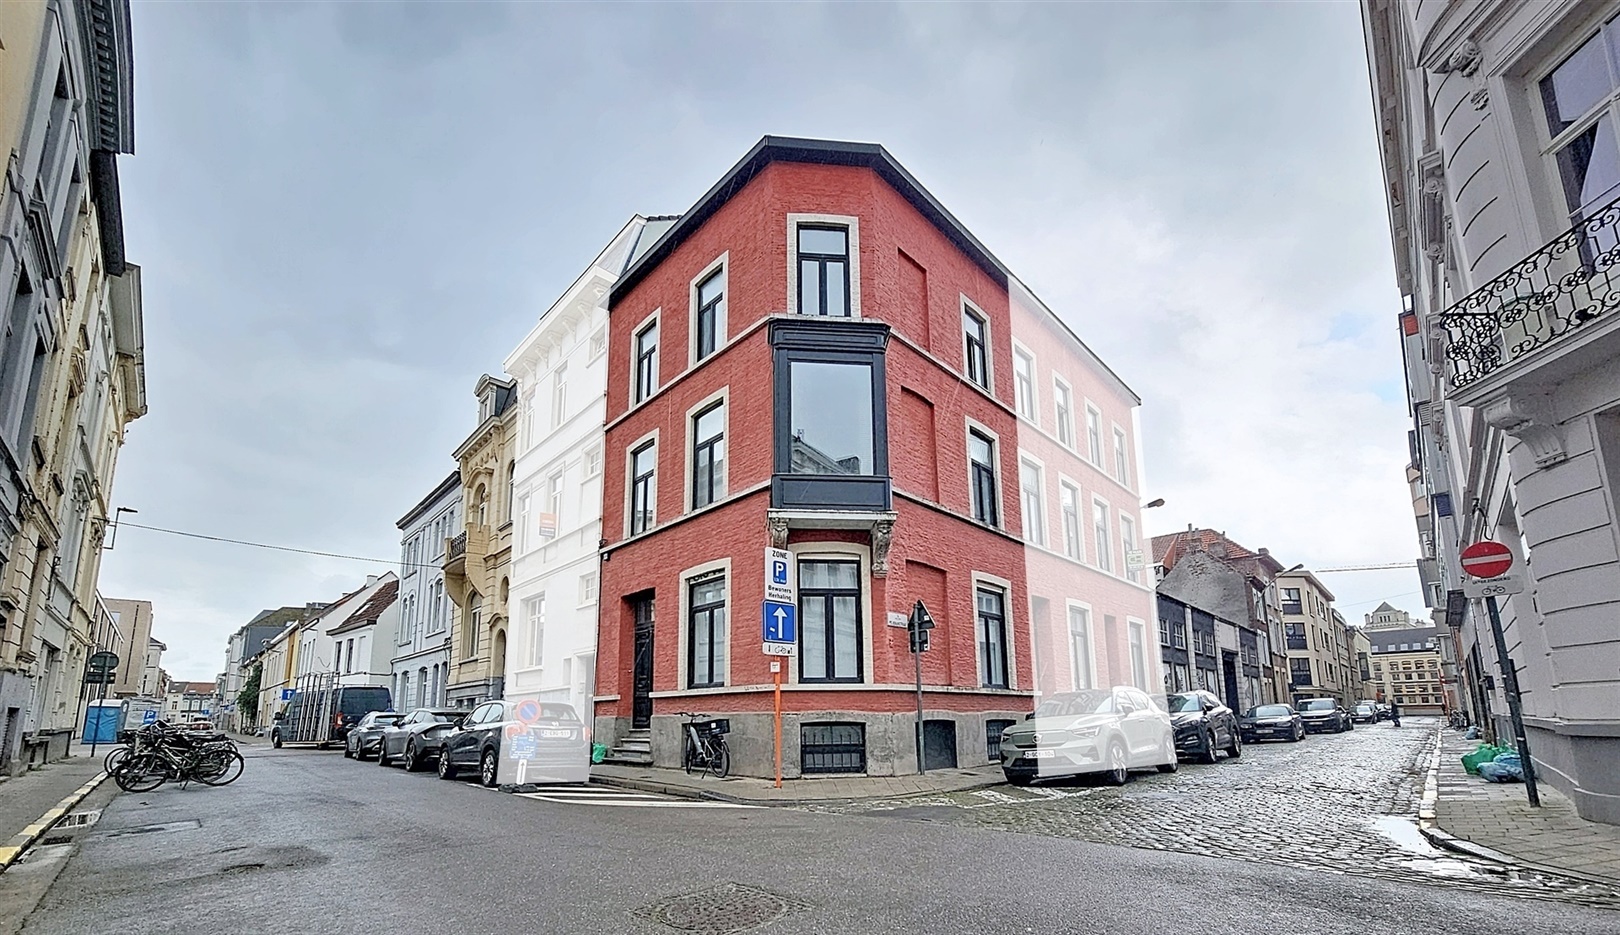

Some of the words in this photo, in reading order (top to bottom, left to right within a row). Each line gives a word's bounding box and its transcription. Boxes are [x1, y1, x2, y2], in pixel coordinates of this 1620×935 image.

[772, 550, 788, 560] ZONE
[775, 562, 784, 577] P
[768, 584, 792, 594] Bewoners
[768, 592, 792, 602] Herhaling
